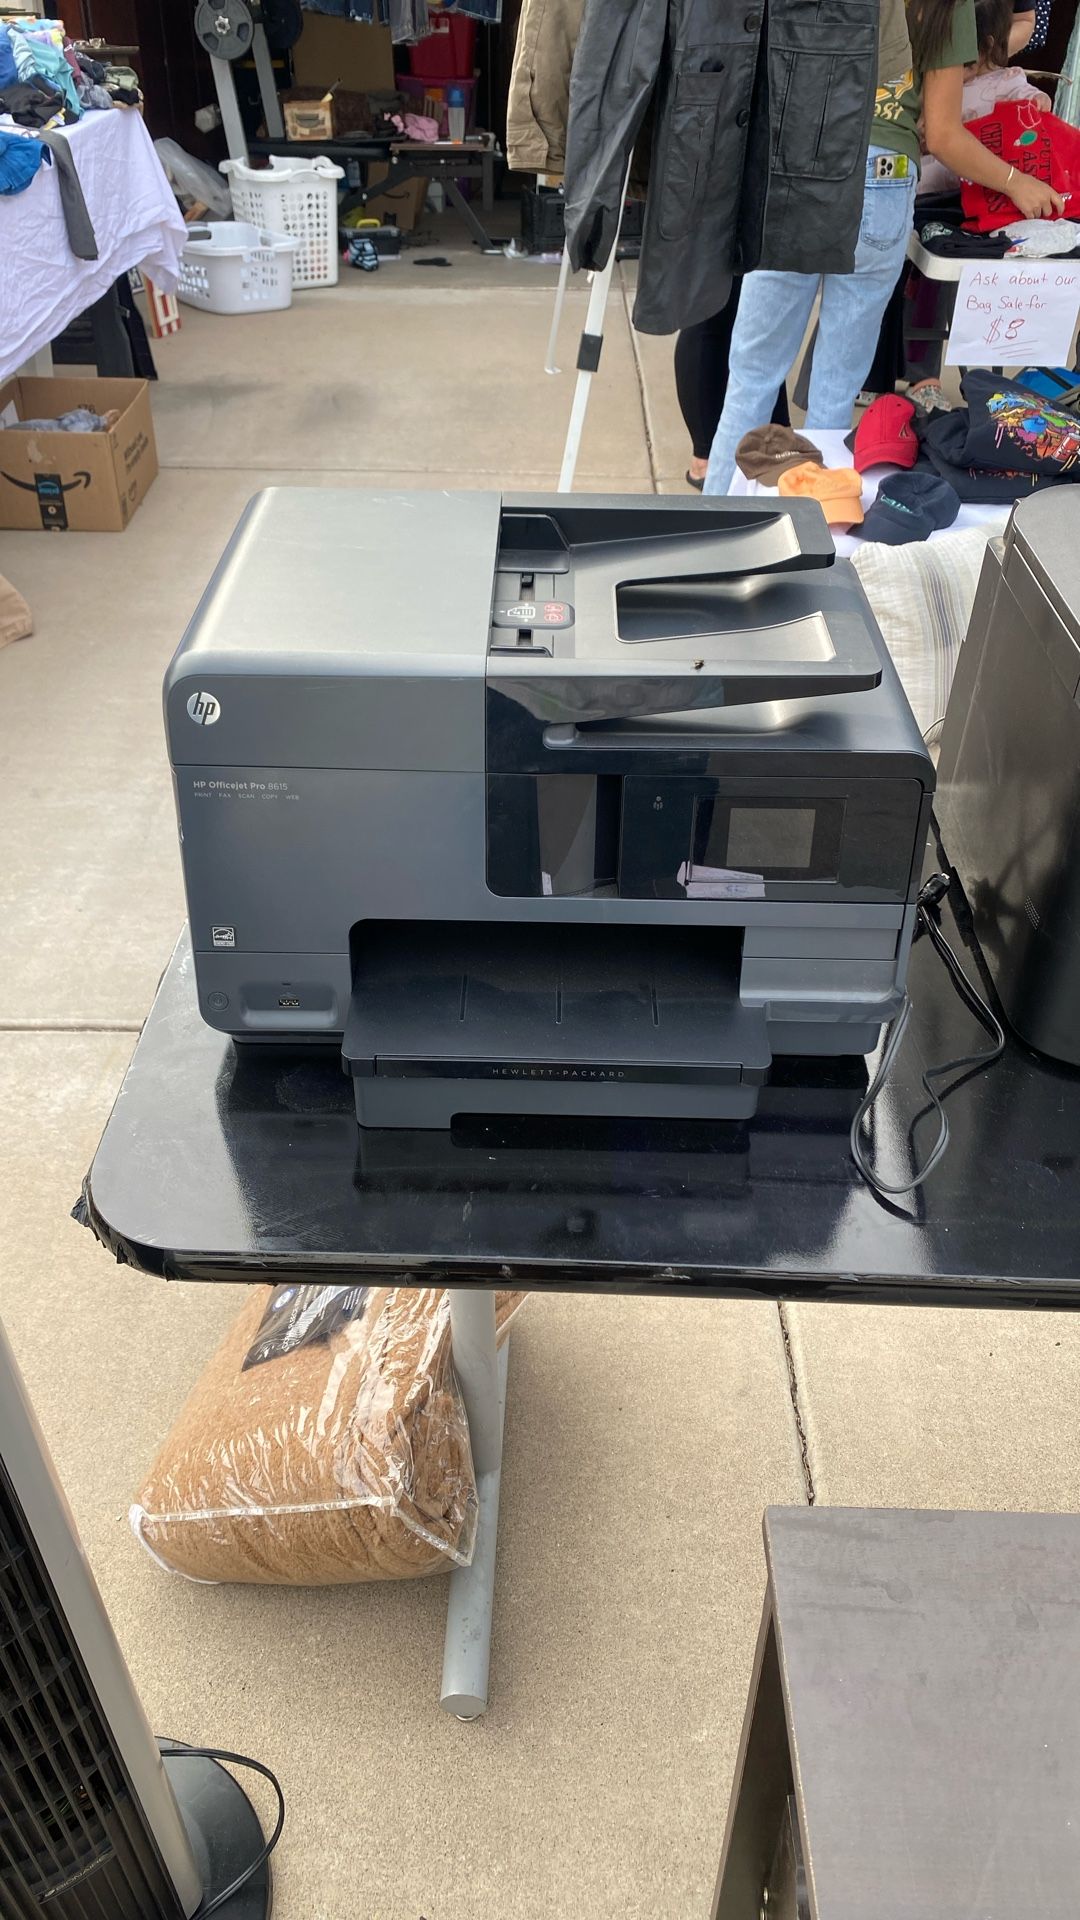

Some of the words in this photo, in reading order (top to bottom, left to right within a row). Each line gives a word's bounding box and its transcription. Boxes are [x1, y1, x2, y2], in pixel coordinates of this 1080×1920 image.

[969, 271, 999, 287] Ask
[1009, 270, 1048, 286] about
[1055, 274, 1077, 286] our
[966, 295, 992, 314] Bag
[983, 315, 1026, 345] $8
[192, 691, 216, 725] hp
[193, 781, 206, 789] HP
[208, 781, 248, 791] Officejet
[250, 782, 266, 790] Pro
[268, 783, 288, 791] 8615
[492, 1068, 626, 1078] HEWLETT-PACKARD
